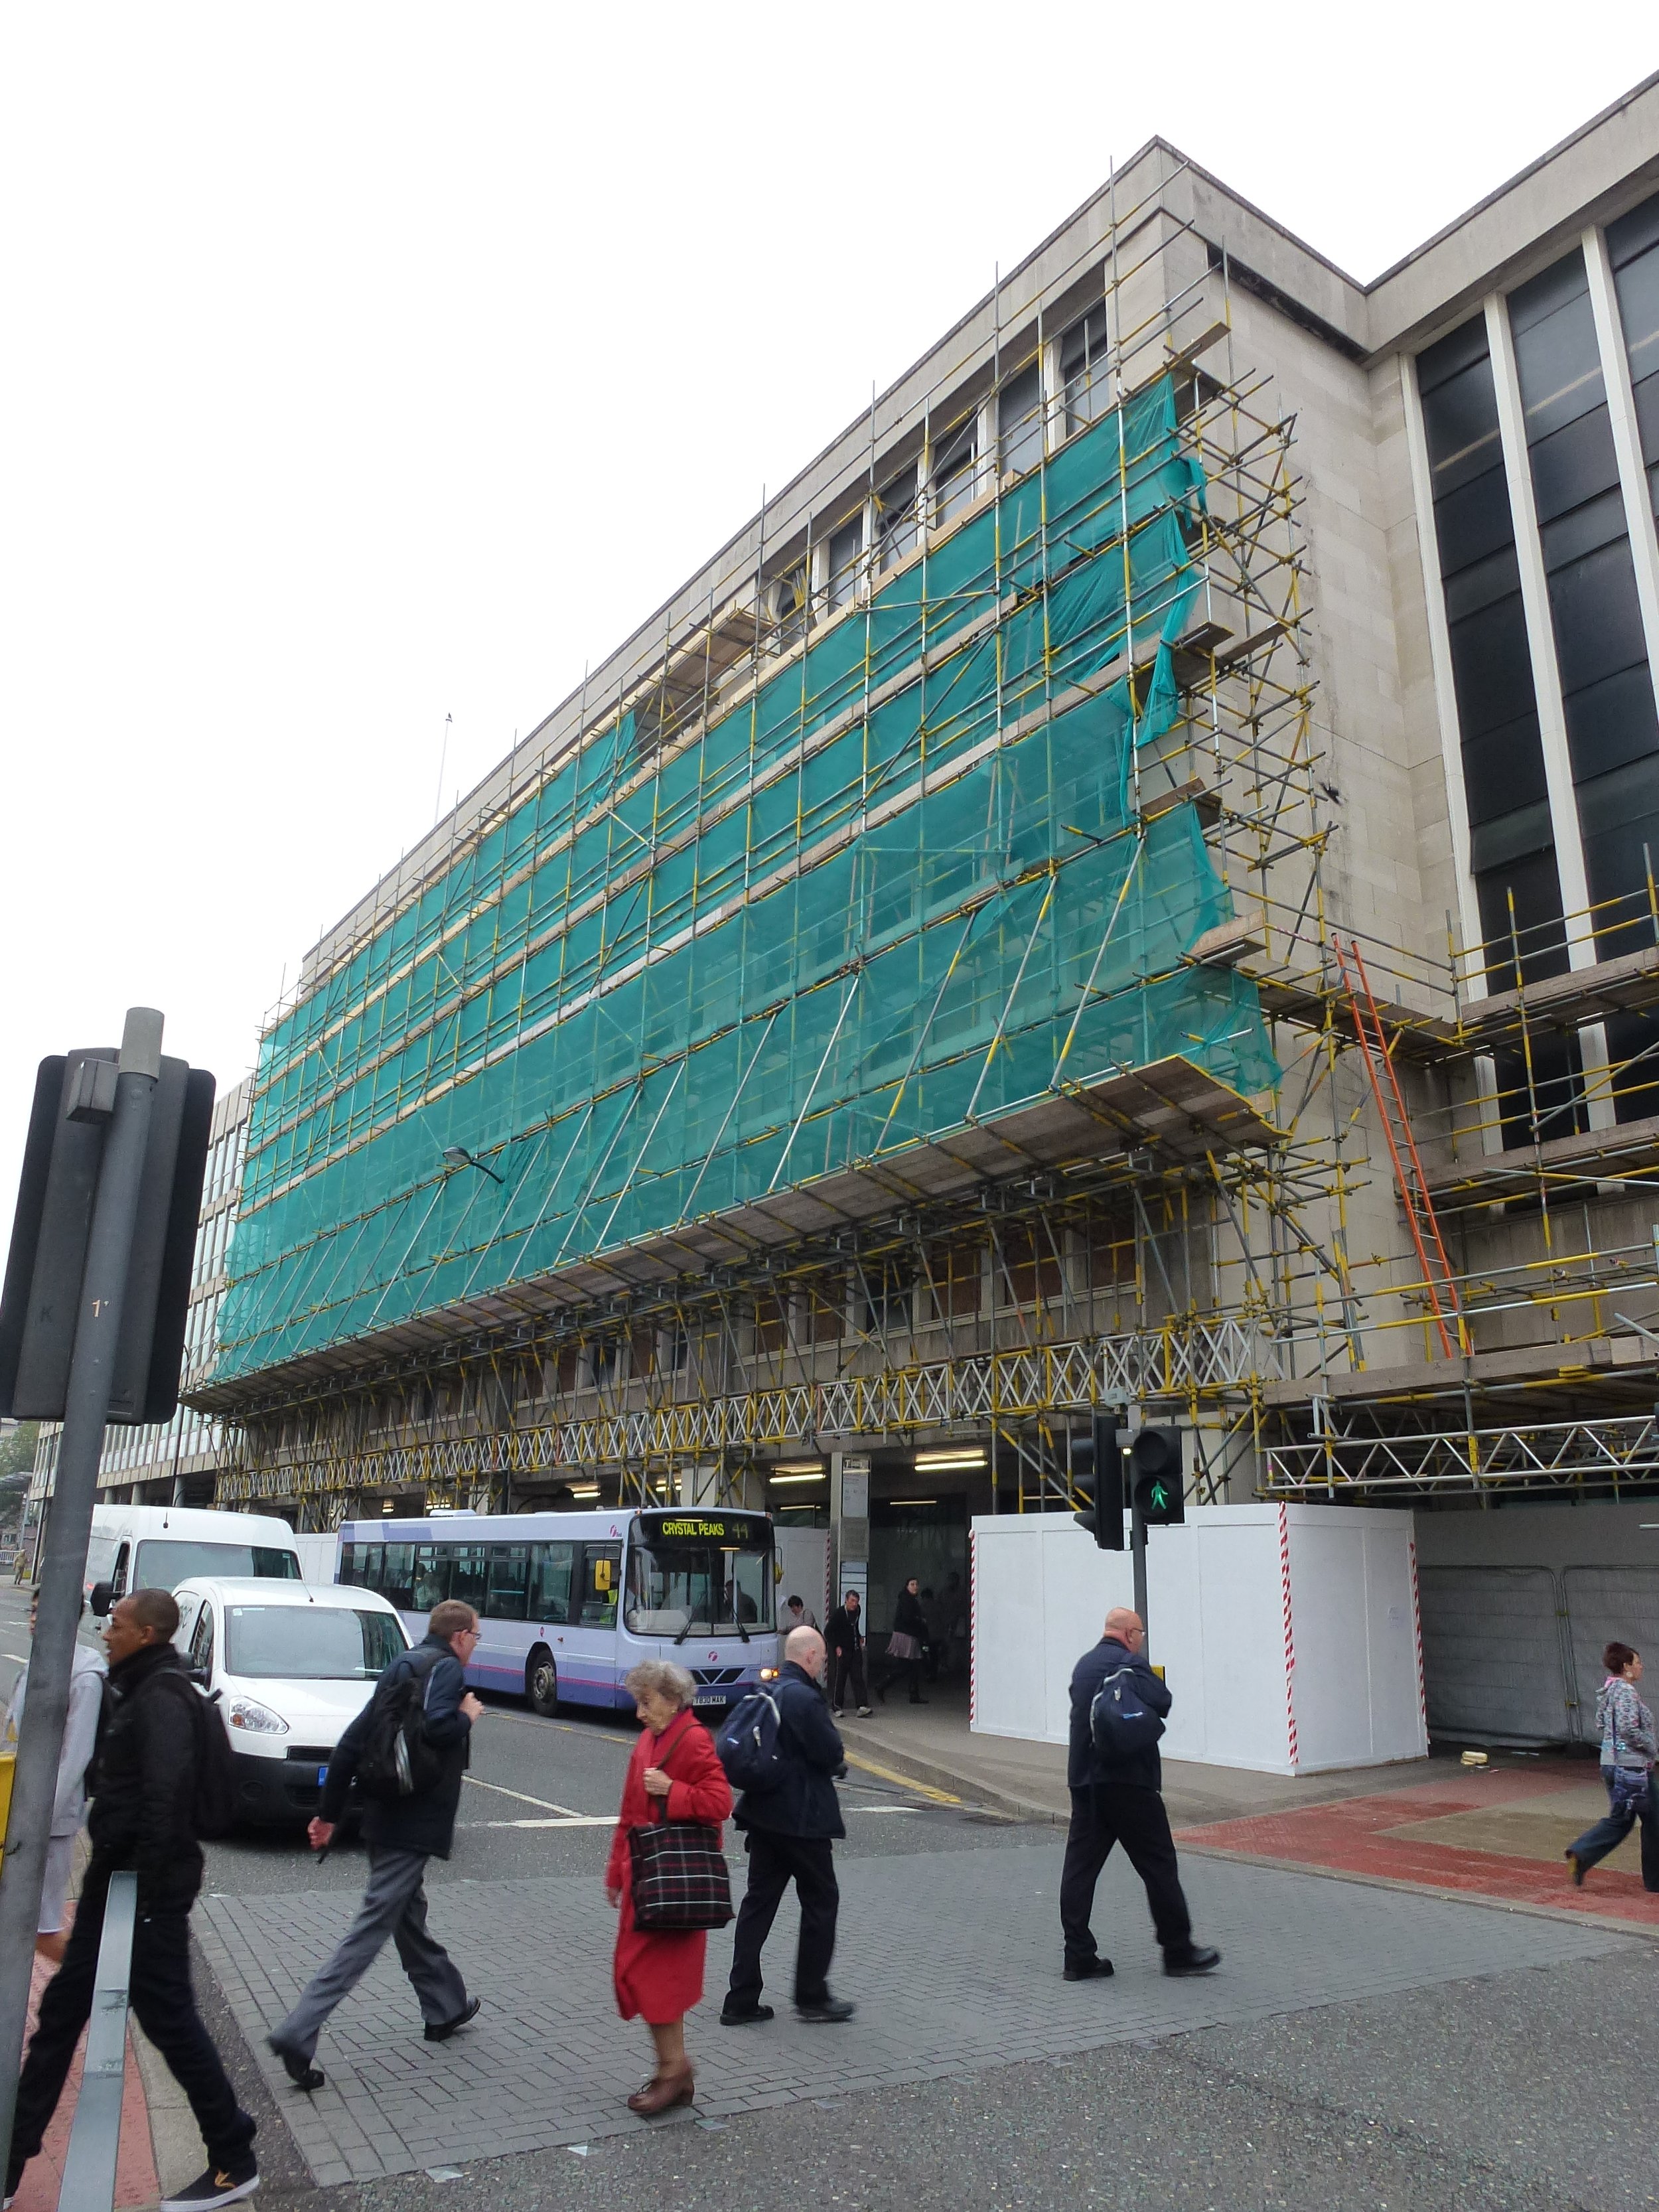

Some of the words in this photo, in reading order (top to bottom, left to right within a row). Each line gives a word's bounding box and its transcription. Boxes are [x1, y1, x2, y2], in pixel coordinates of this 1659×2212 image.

[662, 1522, 697, 1535] CRYSTAL
[698, 1523, 725, 1536] PEAKS
[732, 1524, 749, 1539] 44
